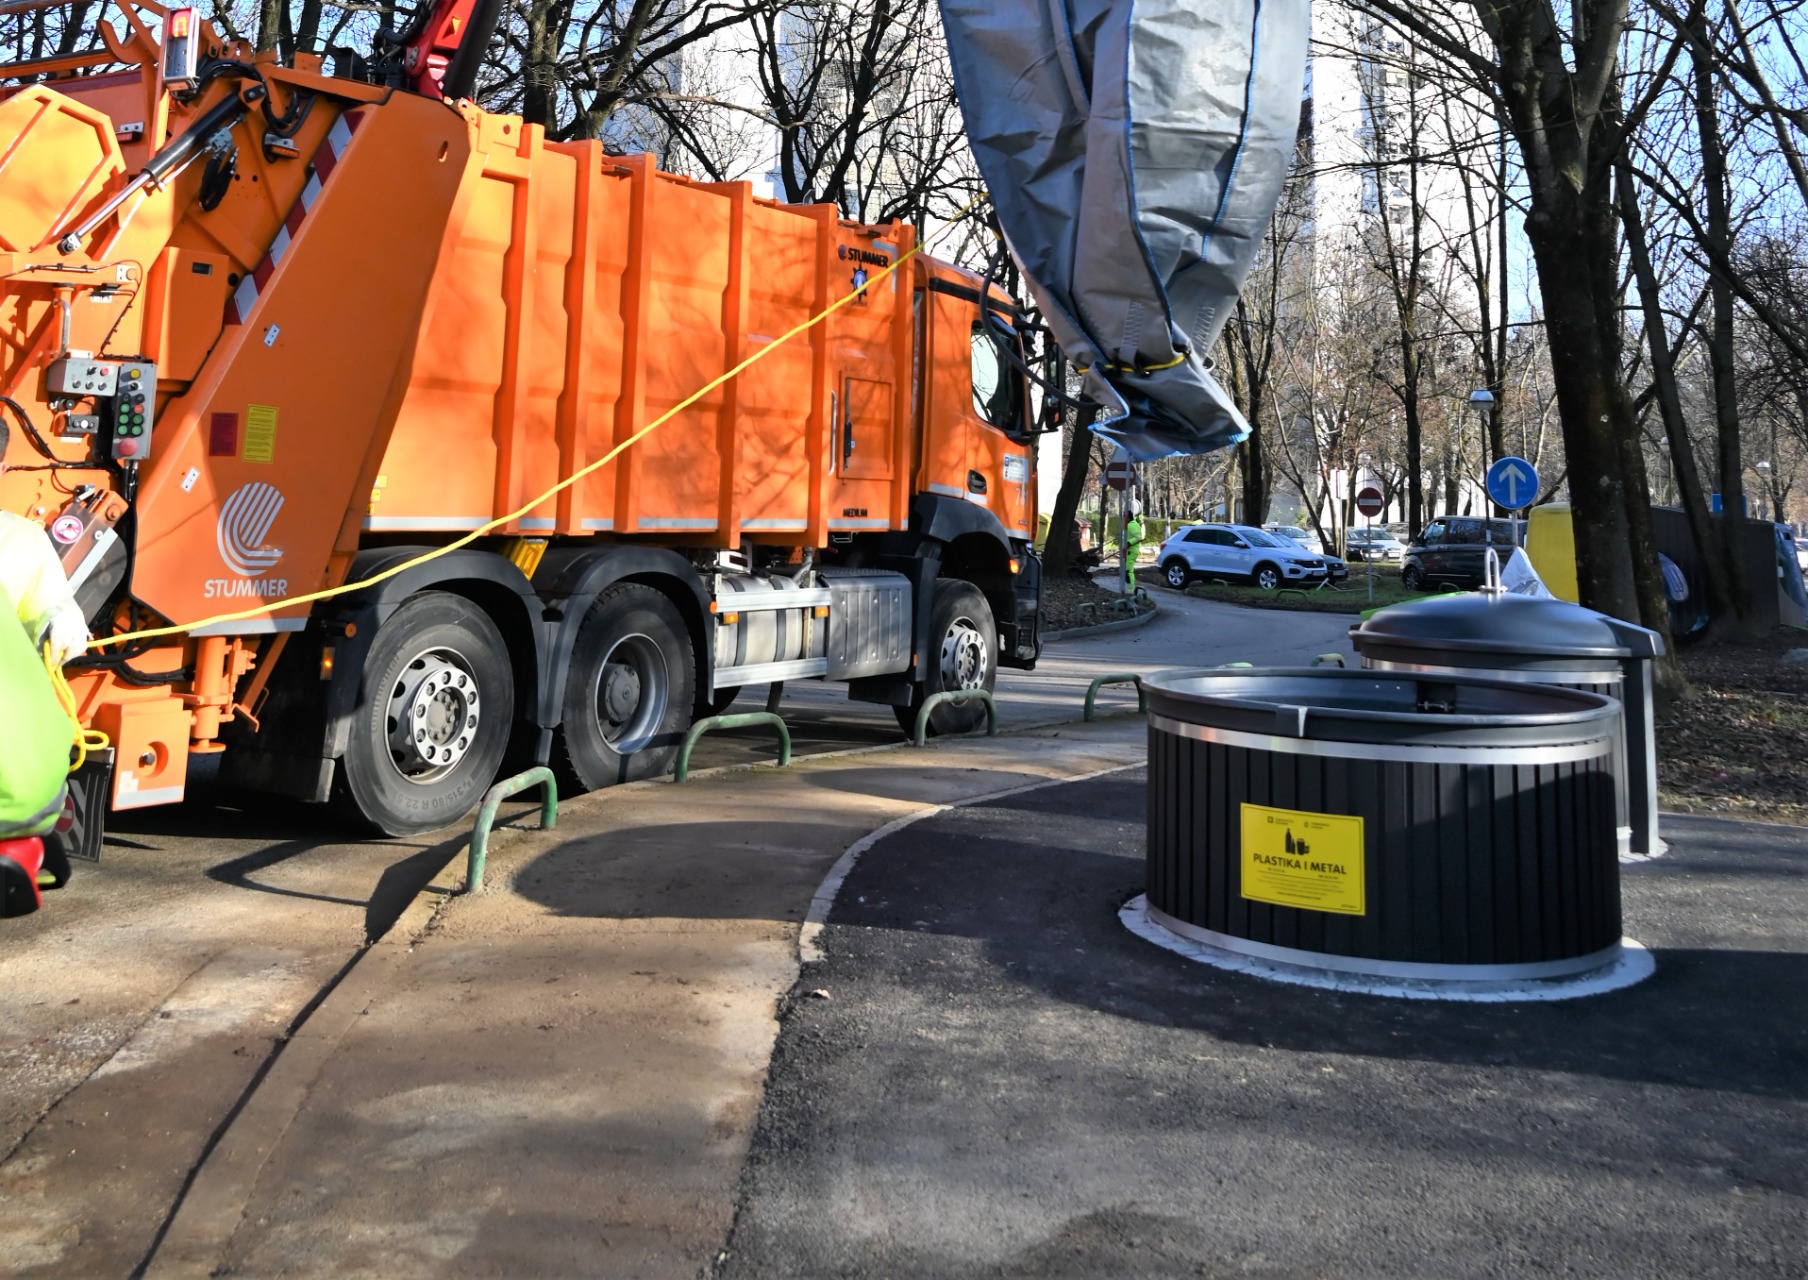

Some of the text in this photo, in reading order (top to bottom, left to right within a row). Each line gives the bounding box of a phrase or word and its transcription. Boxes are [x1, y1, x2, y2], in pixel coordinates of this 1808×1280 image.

[848, 247, 889, 269] STUMMER
[203, 578, 288, 598] STUMMER
[421, 800, 429, 810] R
[1253, 853, 1347, 874] PLASTIKA I METAL
